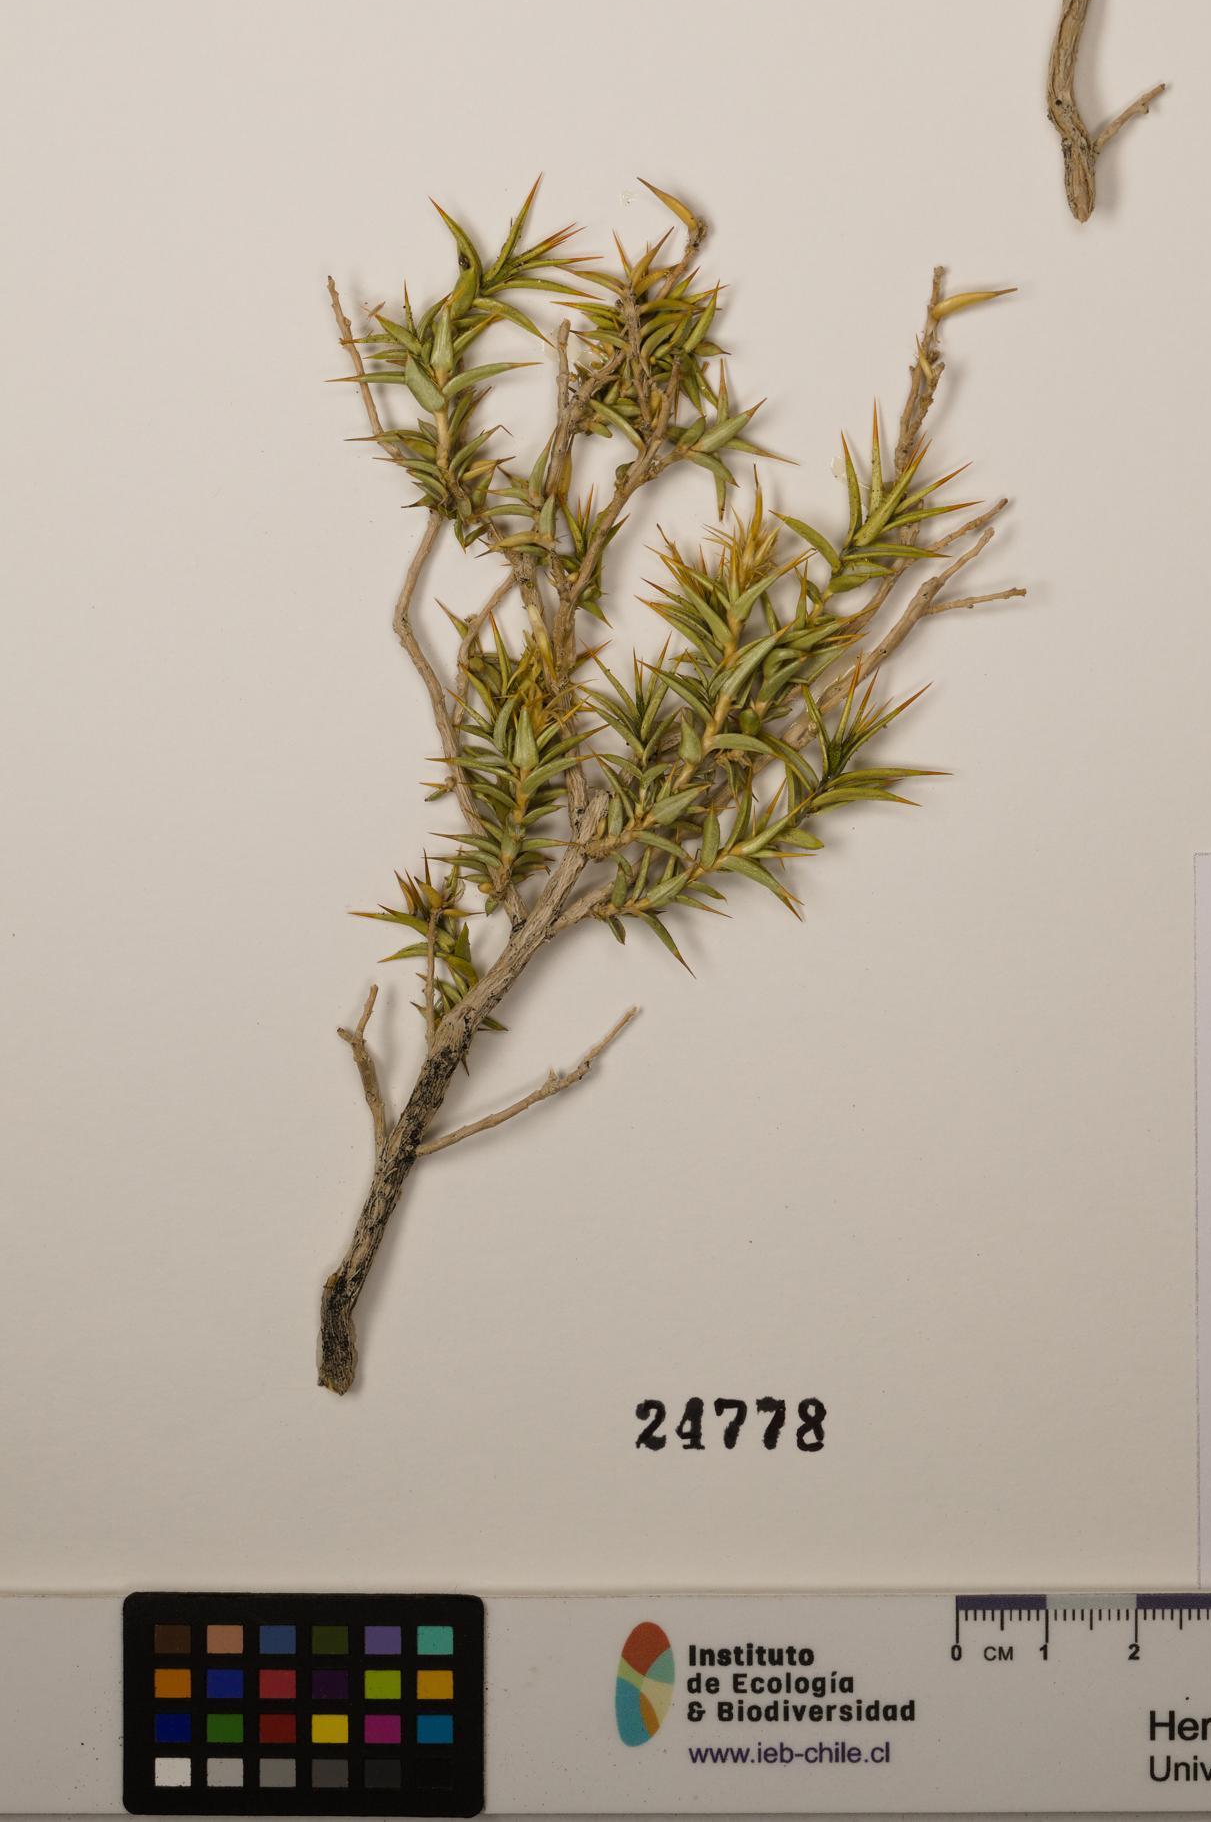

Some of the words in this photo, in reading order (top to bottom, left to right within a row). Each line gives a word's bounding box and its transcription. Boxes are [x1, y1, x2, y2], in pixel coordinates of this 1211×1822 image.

[635, 1395, 828, 1453] 24778
[688, 1643, 816, 1667] Instituto
[950, 1644, 963, 1662] 0
[983, 1645, 1014, 1662] CM
[1039, 1643, 1049, 1661] 1
[1127, 1643, 1141, 1661] 2
[686, 1672, 720, 1695] de
[732, 1670, 854, 1699] Ecología
[686, 1700, 706, 1723] &
[717, 1699, 916, 1723] Biodiversidad
[688, 1741, 891, 1764] www.ieb-chile.cl
